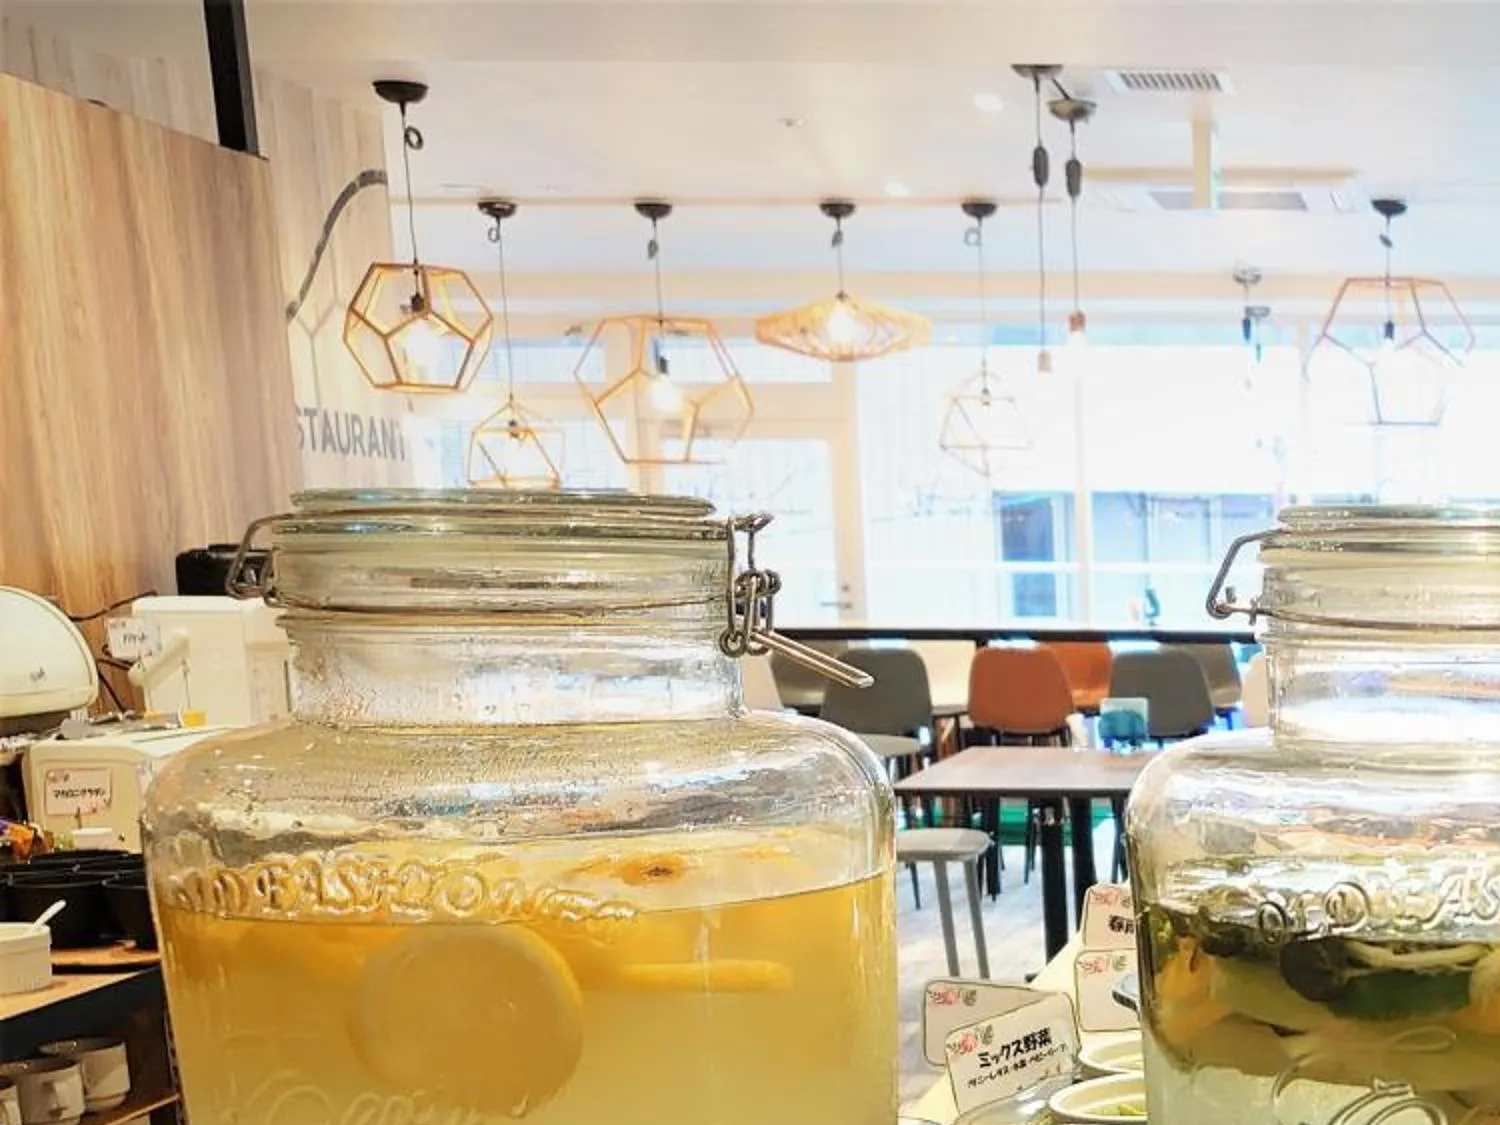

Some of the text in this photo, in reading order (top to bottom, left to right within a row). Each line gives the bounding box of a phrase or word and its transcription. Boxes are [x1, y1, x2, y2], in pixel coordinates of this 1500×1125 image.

[978, 1027, 1052, 1069] ミックス野菜
